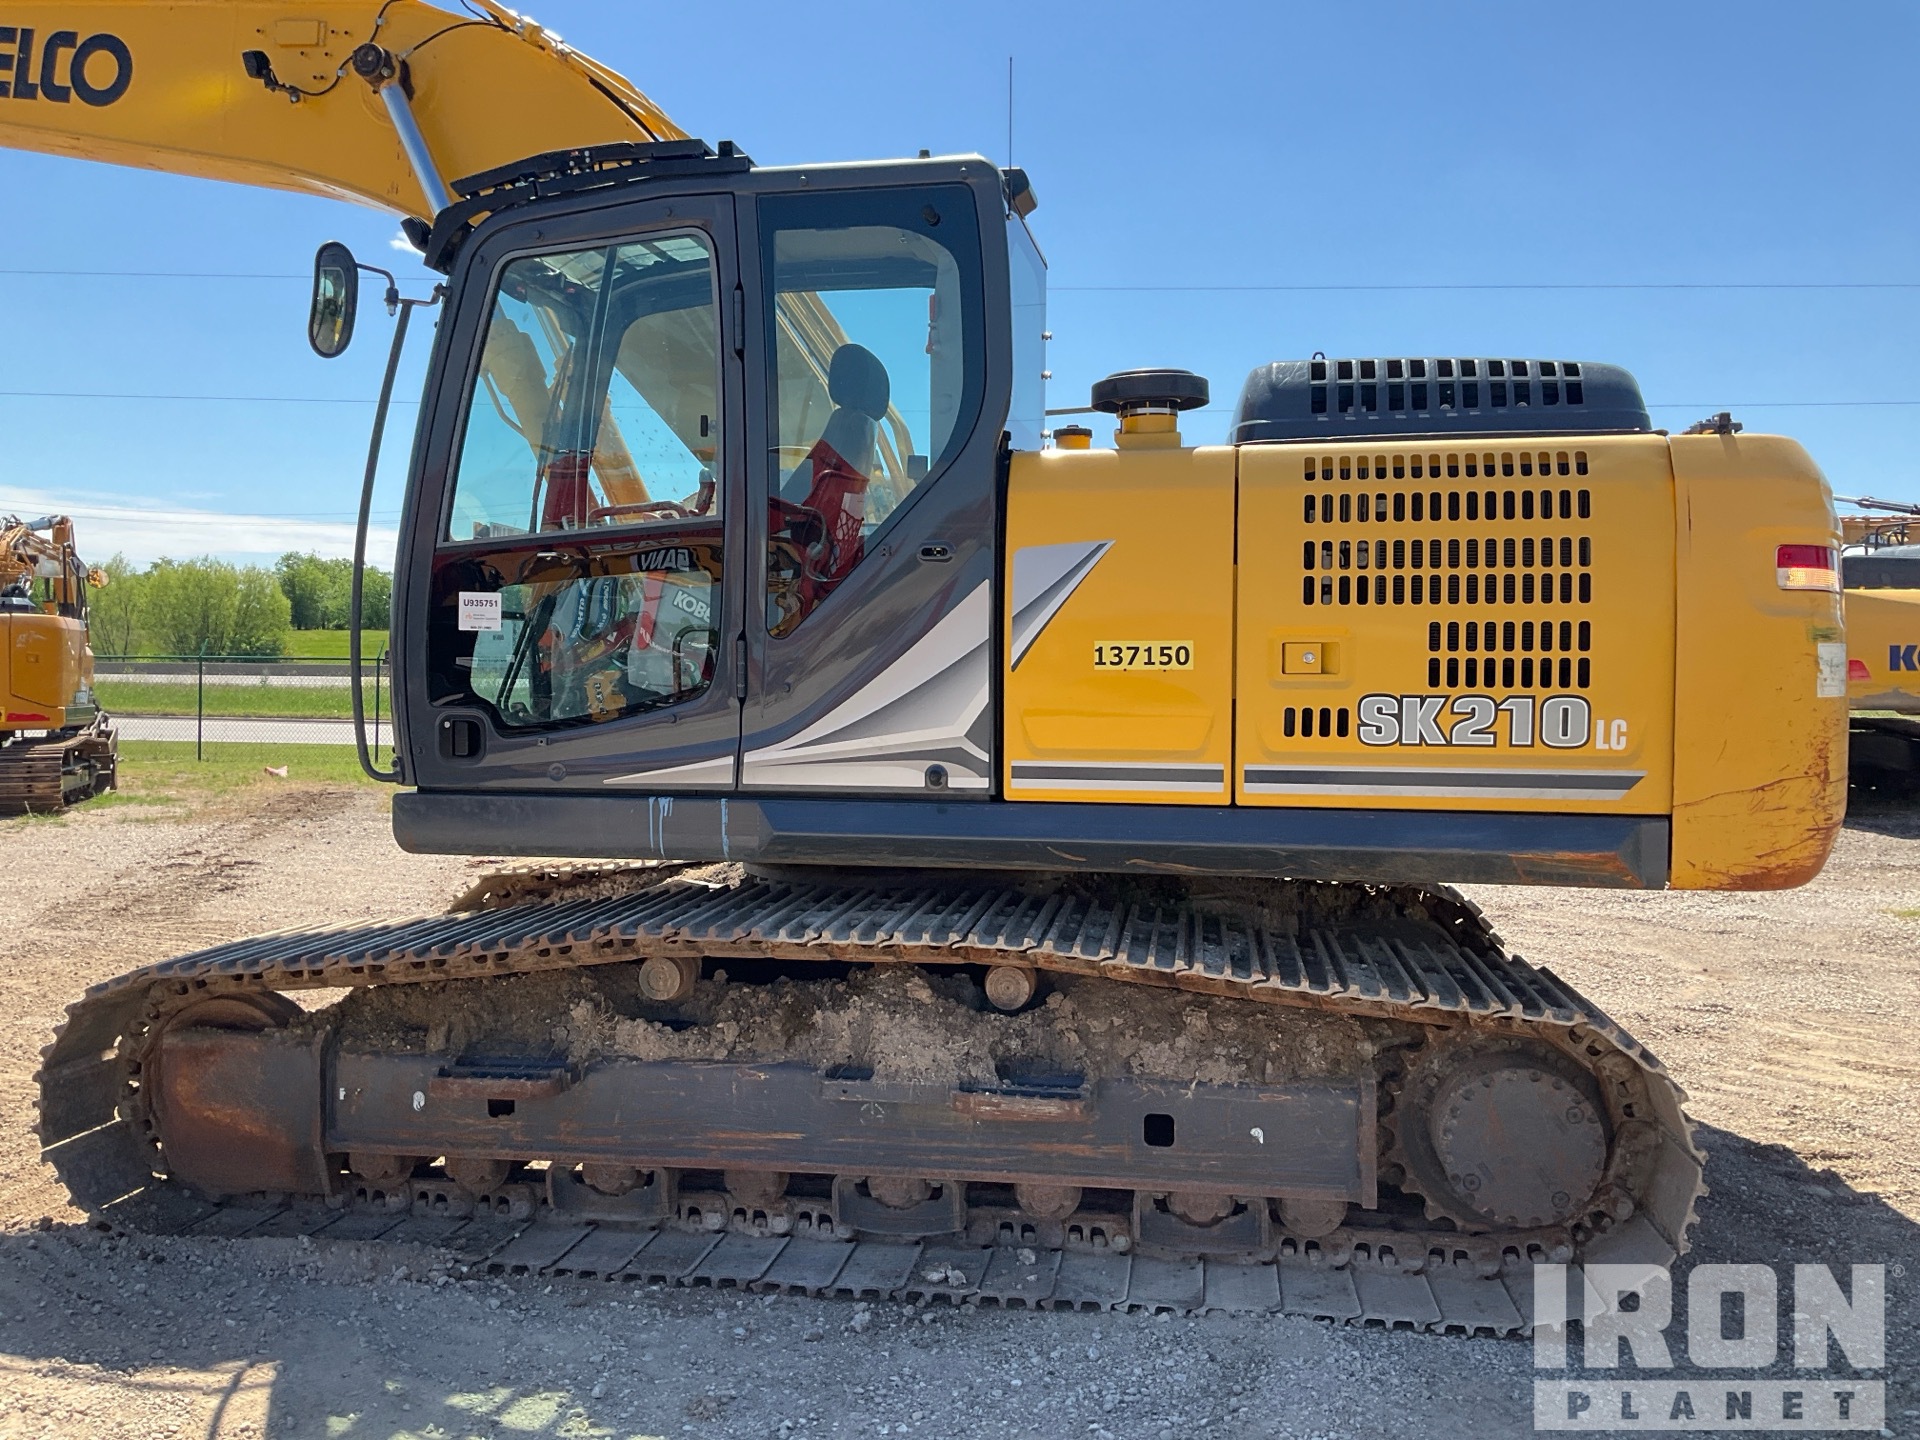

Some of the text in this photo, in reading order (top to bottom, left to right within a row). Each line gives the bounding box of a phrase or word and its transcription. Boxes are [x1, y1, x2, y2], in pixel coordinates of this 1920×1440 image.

[463, 599, 498, 608] U935751
[1093, 644, 1192, 667] 137150
[1889, 644, 1920, 671] K
[1357, 692, 1628, 751] SK210 LC
